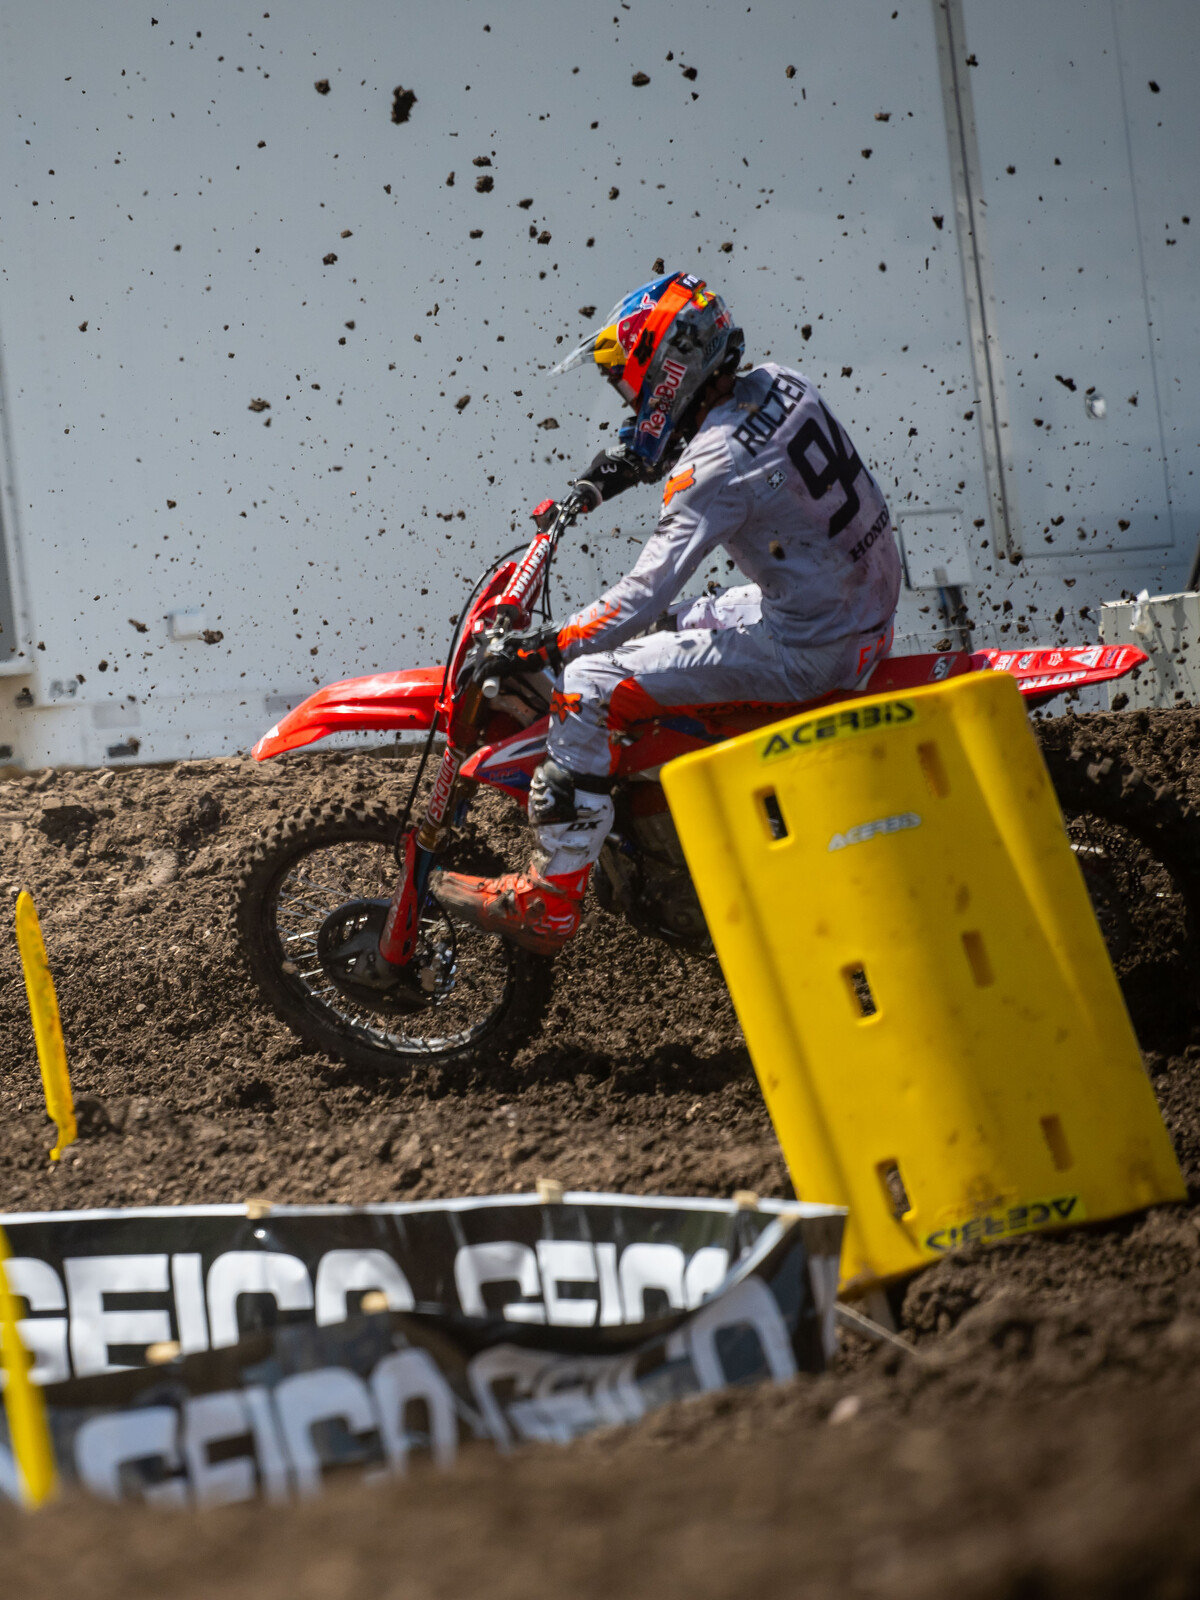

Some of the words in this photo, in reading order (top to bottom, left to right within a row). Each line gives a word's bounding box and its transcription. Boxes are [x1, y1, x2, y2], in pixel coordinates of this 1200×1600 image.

[682, 273, 700, 288] FO
[654, 358, 688, 401] Bull
[787, 398, 875, 540] 94
[508, 538, 550, 600] RENTHAL
[1016, 671, 1088, 691] NLOP
[761, 701, 916, 761] ACERBIS
